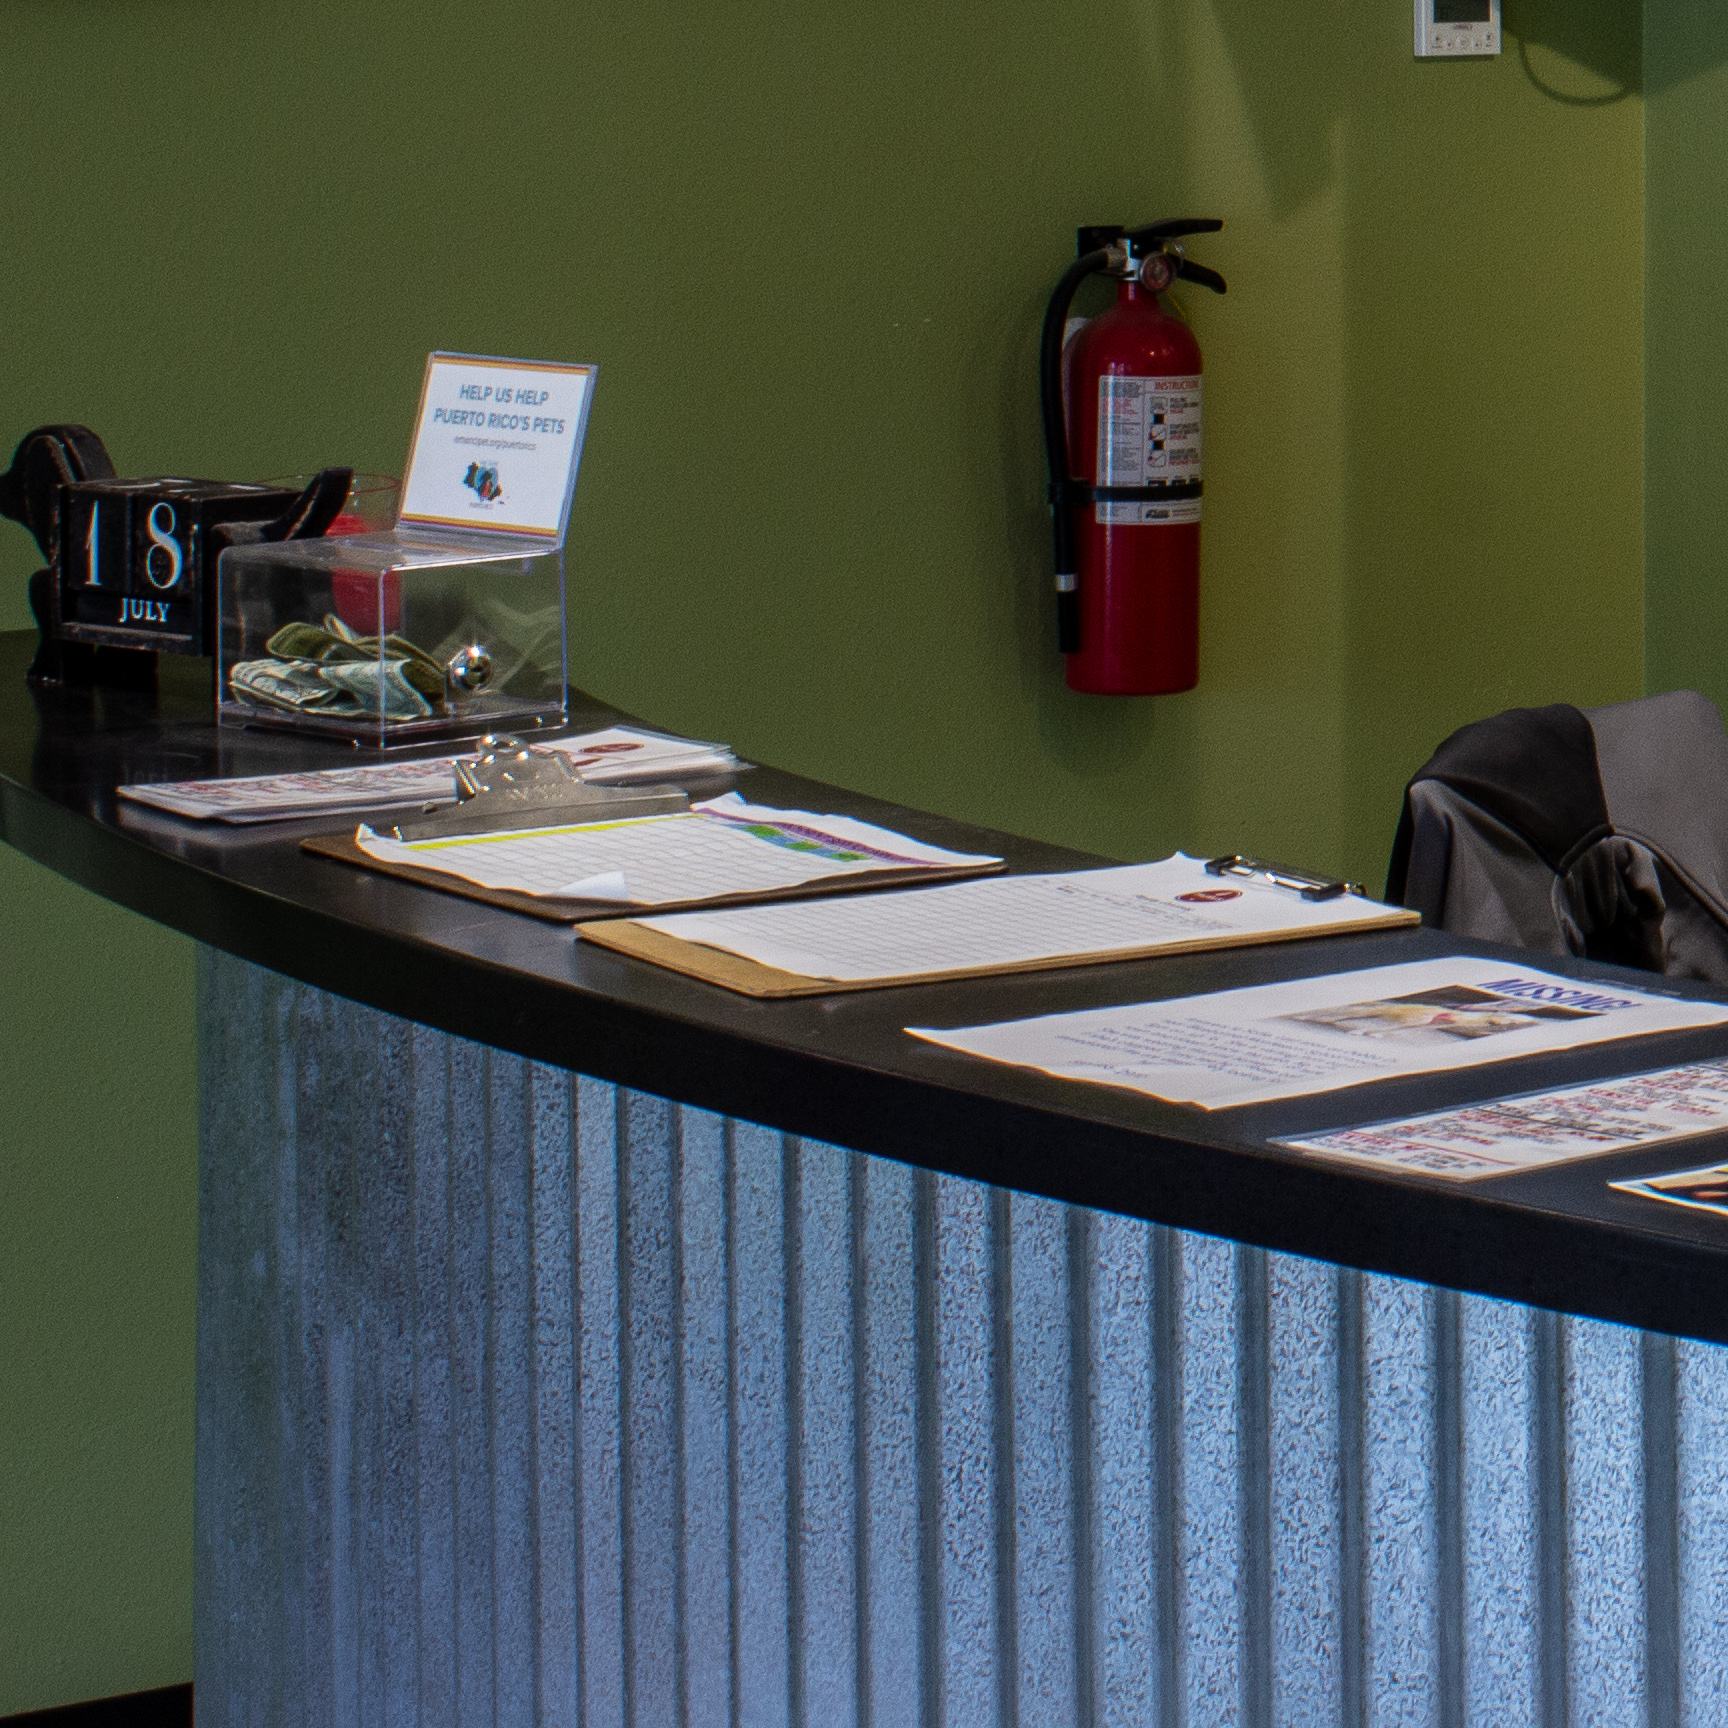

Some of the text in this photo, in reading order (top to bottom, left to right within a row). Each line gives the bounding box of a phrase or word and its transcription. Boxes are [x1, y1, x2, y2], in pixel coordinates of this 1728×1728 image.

[459, 384, 549, 405] HELP US HELP
[433, 407, 566, 434] PUERTO RICO'S PETS
[118, 597, 171, 624] JULY
[1477, 978, 1643, 1011] MISSING!
